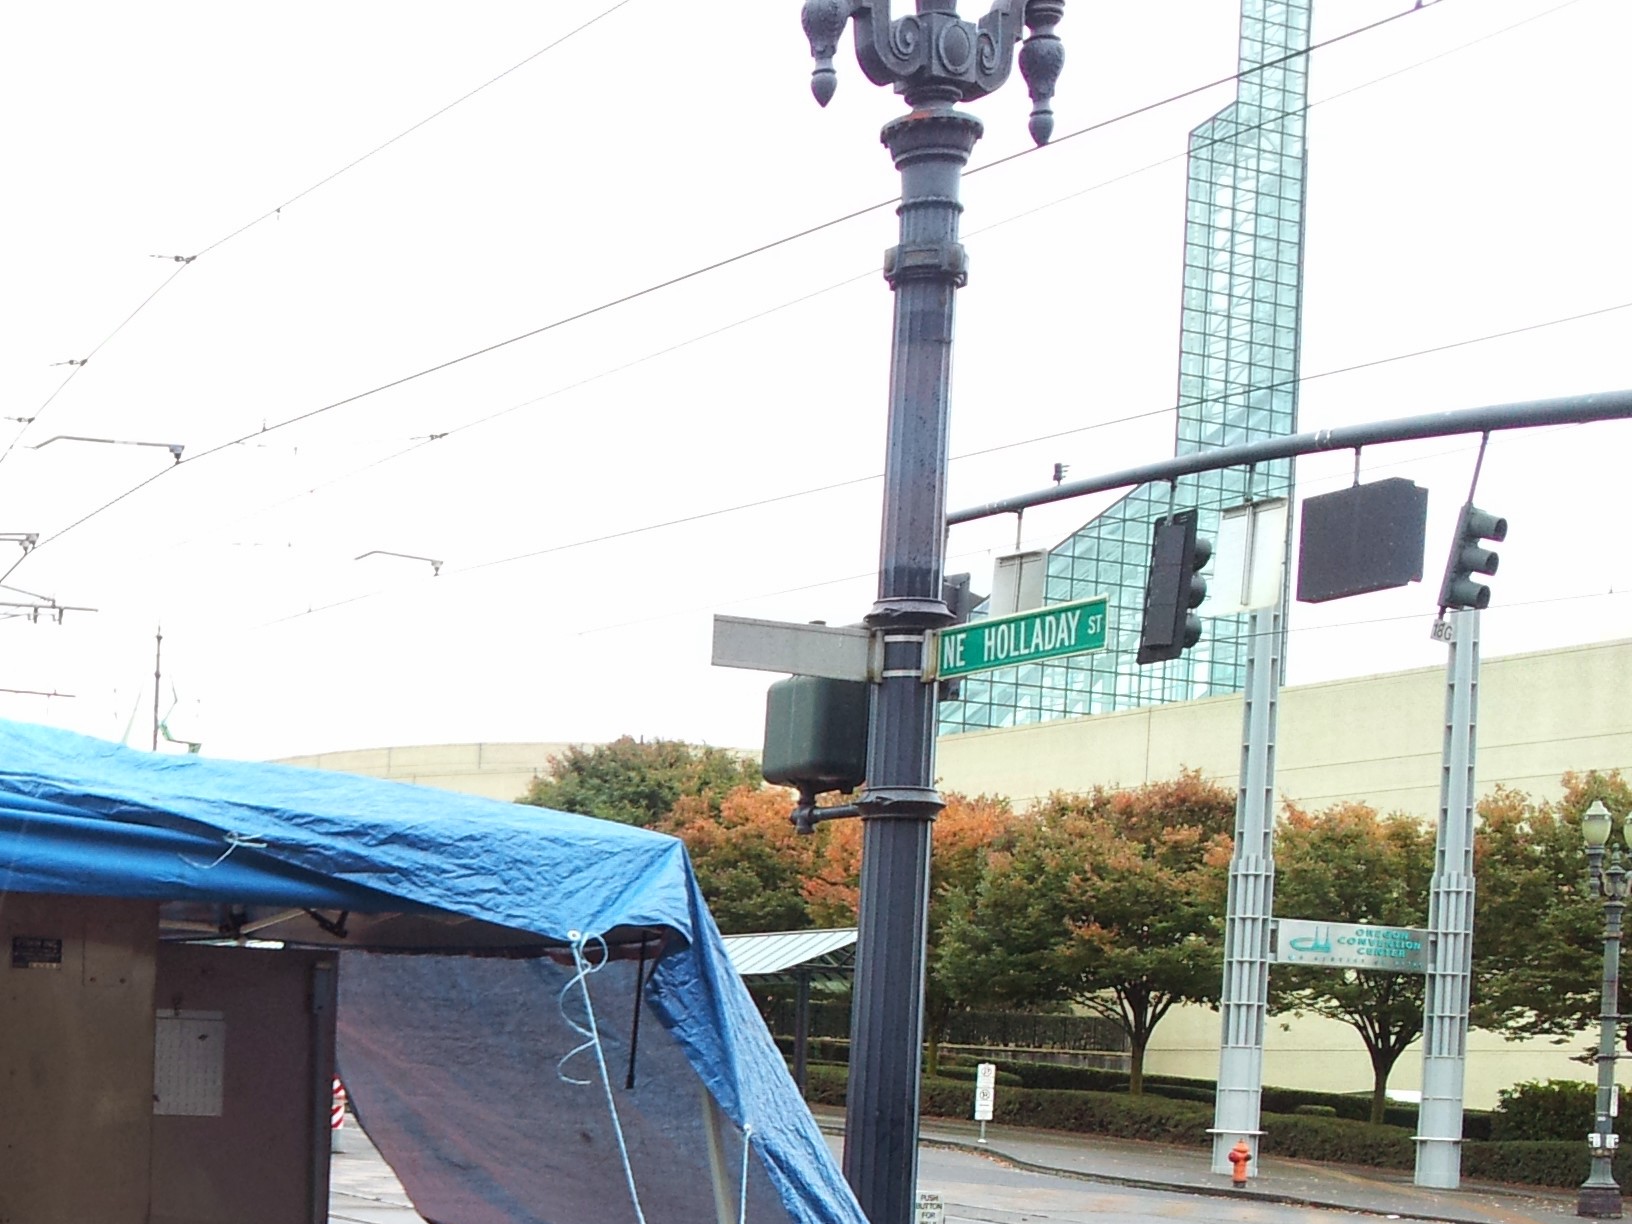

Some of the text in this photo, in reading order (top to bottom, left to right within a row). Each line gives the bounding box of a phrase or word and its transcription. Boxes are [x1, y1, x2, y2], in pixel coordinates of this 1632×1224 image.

[943, 608, 1103, 670] NE HOLLADAY ST
[1355, 928, 1410, 940] OREGON
[1337, 936, 1421, 950] CONVENTION
[1357, 947, 1407, 958] CENTER
